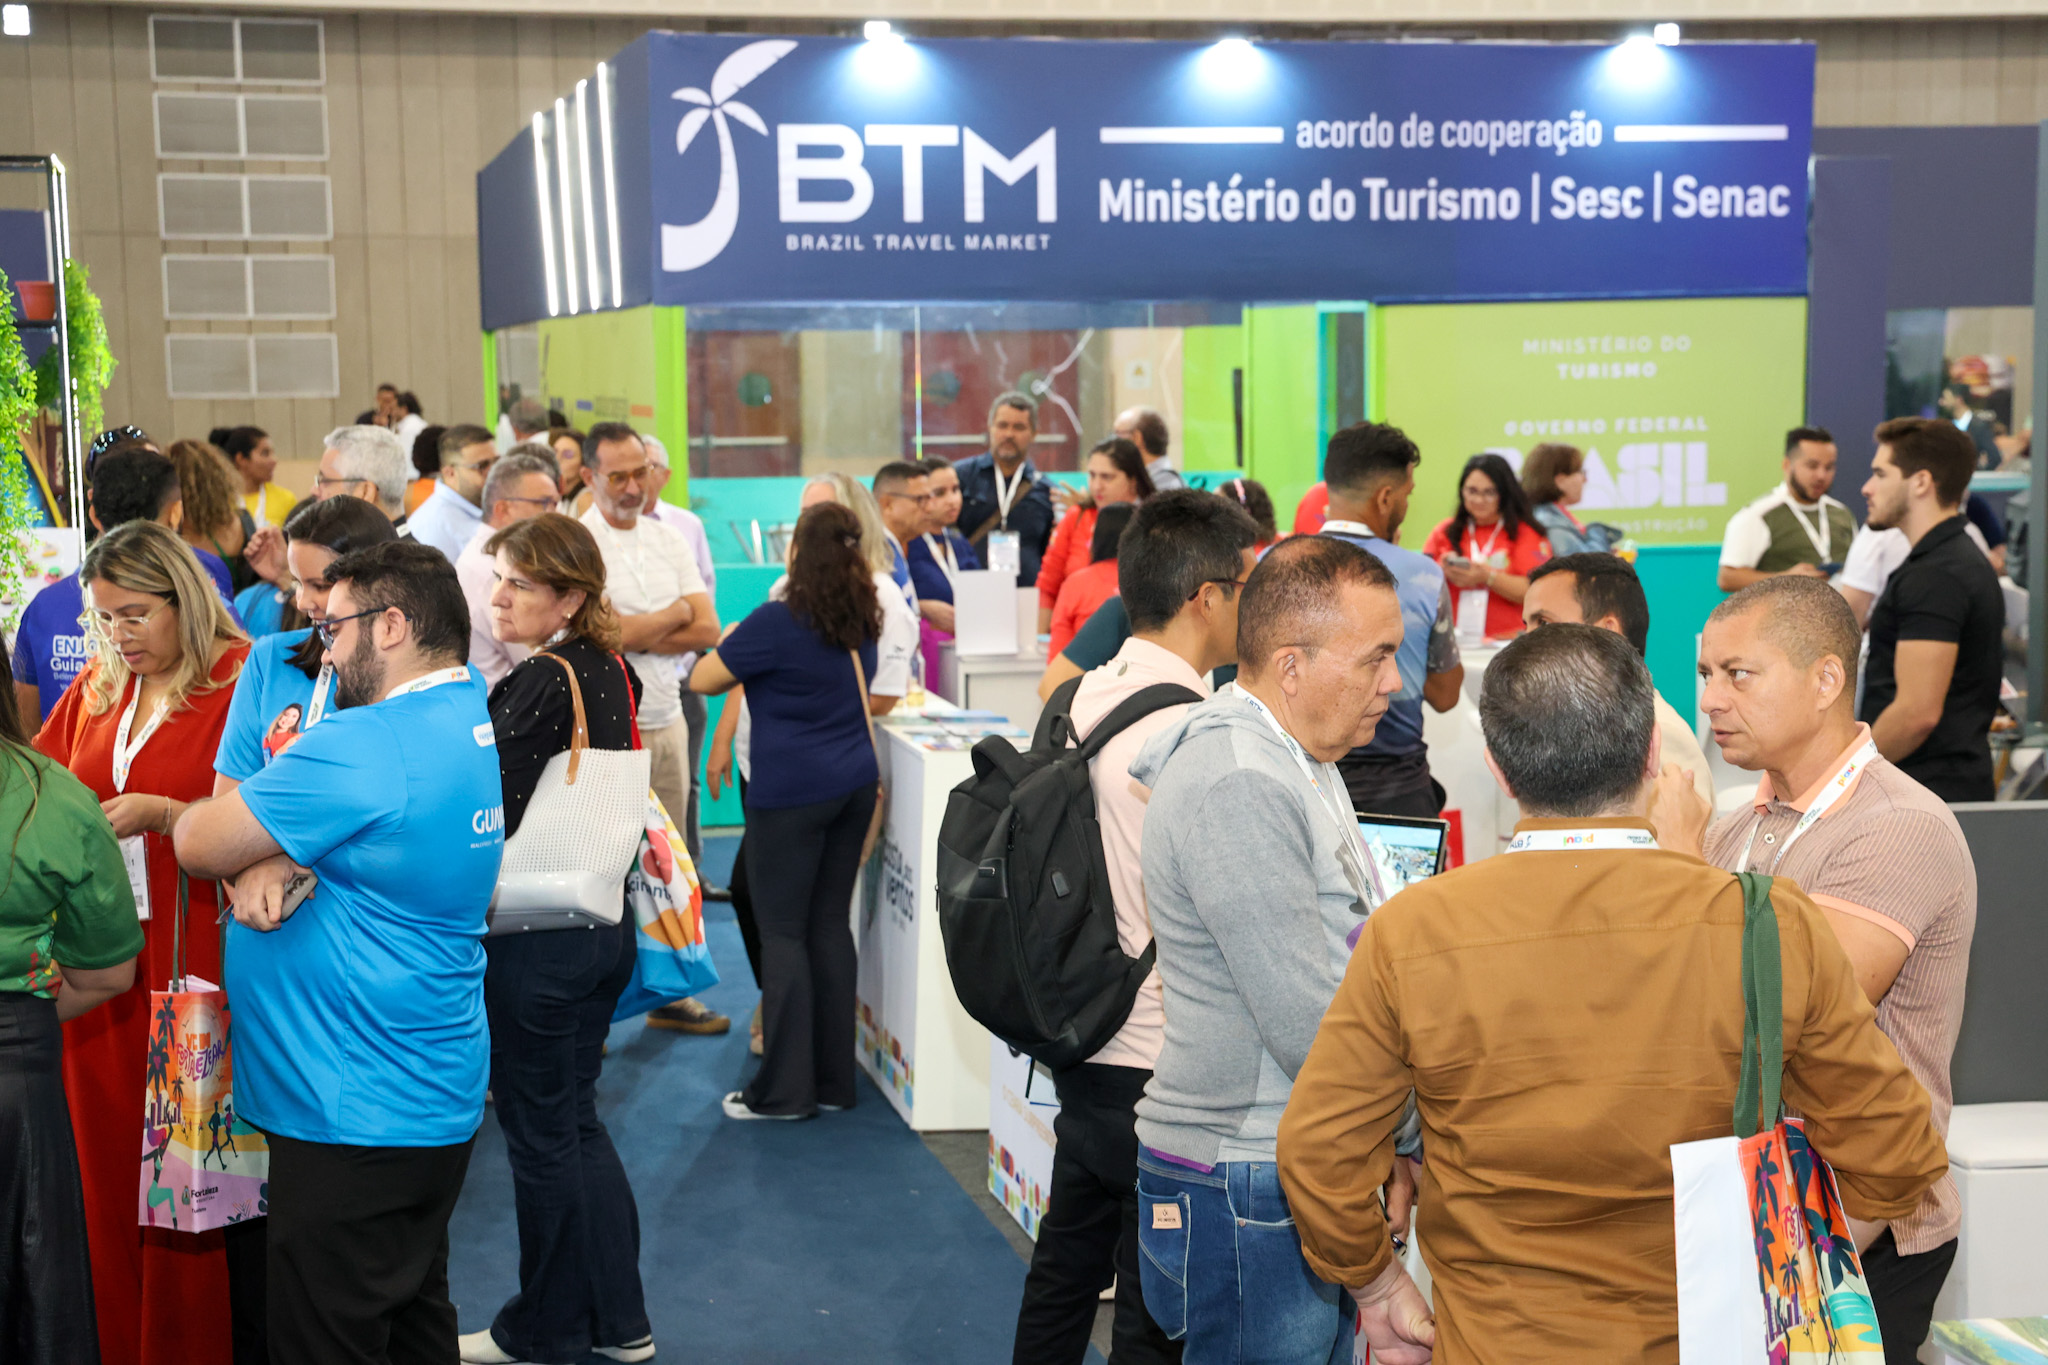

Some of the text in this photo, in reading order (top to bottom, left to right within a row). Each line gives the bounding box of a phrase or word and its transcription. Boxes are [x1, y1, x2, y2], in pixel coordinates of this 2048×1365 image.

[1296, 110, 1603, 157] acordo de cooperação
[777, 124, 1058, 223] BTM
[1099, 173, 1791, 223] Ministério do Turismo Sesc Senac
[786, 234, 1051, 251] BRAZIL TRAVEL MARKET
[1522, 334, 1692, 356] MINISTÉRIO DO
[1556, 361, 1658, 380] TURISMO
[1504, 415, 1709, 437] GOVERNO FEDERAL
[1484, 441, 1728, 511] ASIL
[190, 1186, 219, 1199] Fortaleza
